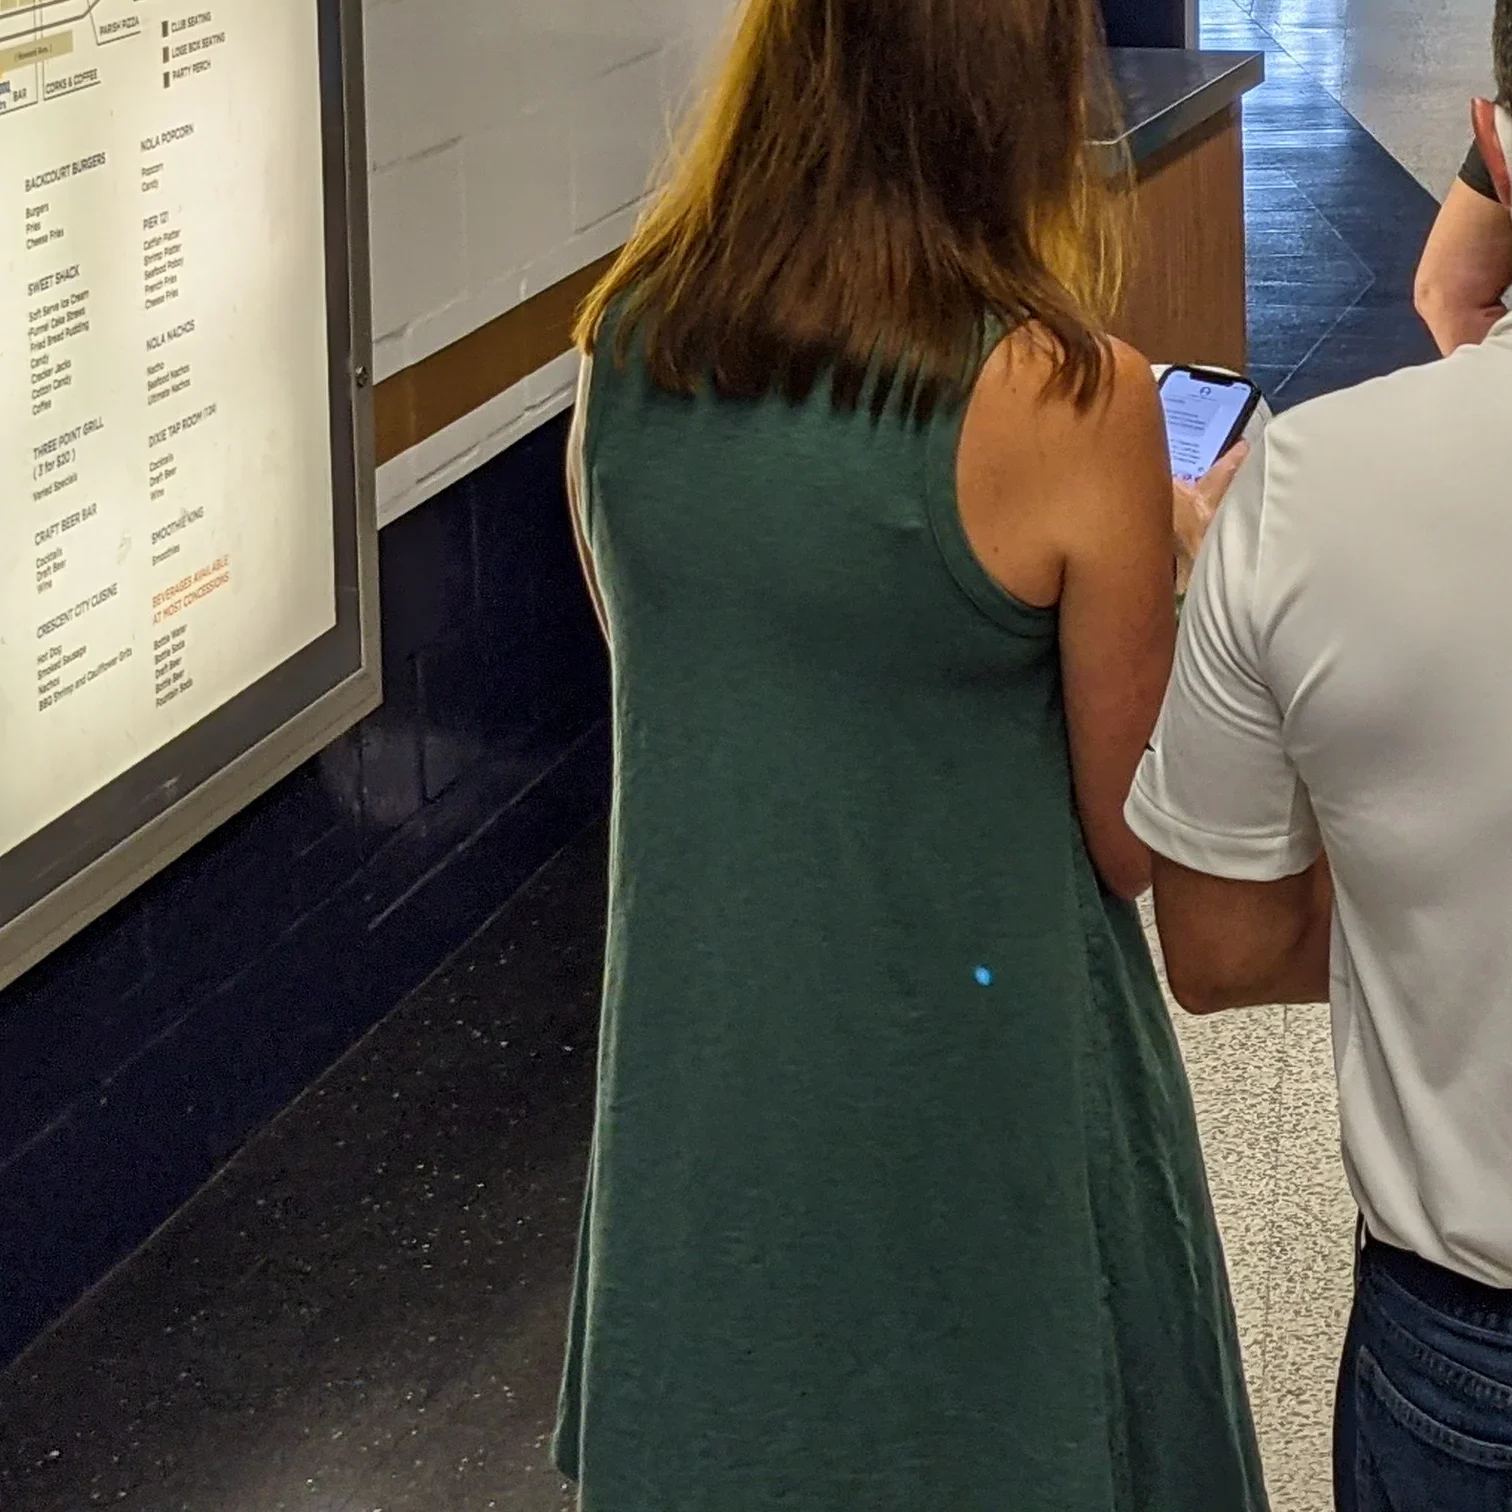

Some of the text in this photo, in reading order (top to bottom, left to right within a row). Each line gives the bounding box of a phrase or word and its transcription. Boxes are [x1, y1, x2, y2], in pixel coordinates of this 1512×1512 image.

[100, 16, 140, 35] PARISH PIZZA
[171, 11, 212, 33] CLUB SEATING
[188, 40, 201, 53] BOX
[201, 32, 226, 49] SEATING
[172, 59, 211, 80] PARTY PERCH
[45, 77, 67, 95] CORKS
[73, 68, 98, 86] COFFEE
[13, 88, 27, 102] BAR
[140, 123, 194, 153] NOLA POPCORN
[25, 152, 106, 193] BACKCOURT BURGERS
[141, 179, 158, 192] Candy
[26, 203, 49, 219] Burgers
[26, 221, 41, 235] Fries
[49, 228, 64, 240] Fries
[143, 229, 181, 251] Catfish Platter
[144, 243, 182, 267] Shrimp Platter
[144, 263, 166, 280] Seafood
[28, 274, 54, 296] SWEET
[145, 274, 177, 296] French Fries
[70, 290, 89, 305] Cream
[145, 288, 178, 310] Cheese Fries
[47, 329, 64, 346] Bread
[65, 320, 89, 336] Pudding
[51, 316, 65, 329] Cake
[146, 319, 195, 352] NOLA NACHOS
[31, 354, 49, 369] Candy
[32, 374, 71, 400] Cotton Candy
[147, 364, 190, 391] Seafood Nachos
[148, 379, 191, 405] Ultimate Nachos
[32, 400, 51, 415] Coffee
[33, 416, 104, 460] THREE POINT GRILL
[149, 411, 202, 448] DIXIE TAP ROOM
[57, 451, 70, 468] $20
[149, 452, 174, 472] Cocktails
[54, 472, 77, 491] Specials
[149, 467, 177, 487] Draft Beer
[35, 502, 97, 546] CRAFT BEER BAR
[152, 506, 203, 545] SMOOTHIE KING
[36, 548, 62, 569] Cocktails
[152, 544, 180, 566] Smoothies
[36, 559, 66, 582] Draft Beer
[152, 554, 229, 608] BEVERAGES AVAILABLE
[152, 571, 229, 625] AT MOST CONCESSIONS
[37, 582, 117, 639] CRESCENT CITY CUISINE
[154, 635, 170, 650] Bottle
[154, 640, 185, 665] Bottle Soda
[38, 645, 62, 664] Hot Dog
[38, 645, 86, 680] Smoked Sausage
[155, 657, 181, 679] Draft Beer
[38, 676, 60, 694] Nachos
[53, 683, 74, 702] Shrimp
[75, 673, 86, 688] and
[155, 669, 184, 694] Bottle Beer
[156, 677, 193, 708] Fountain Soda
